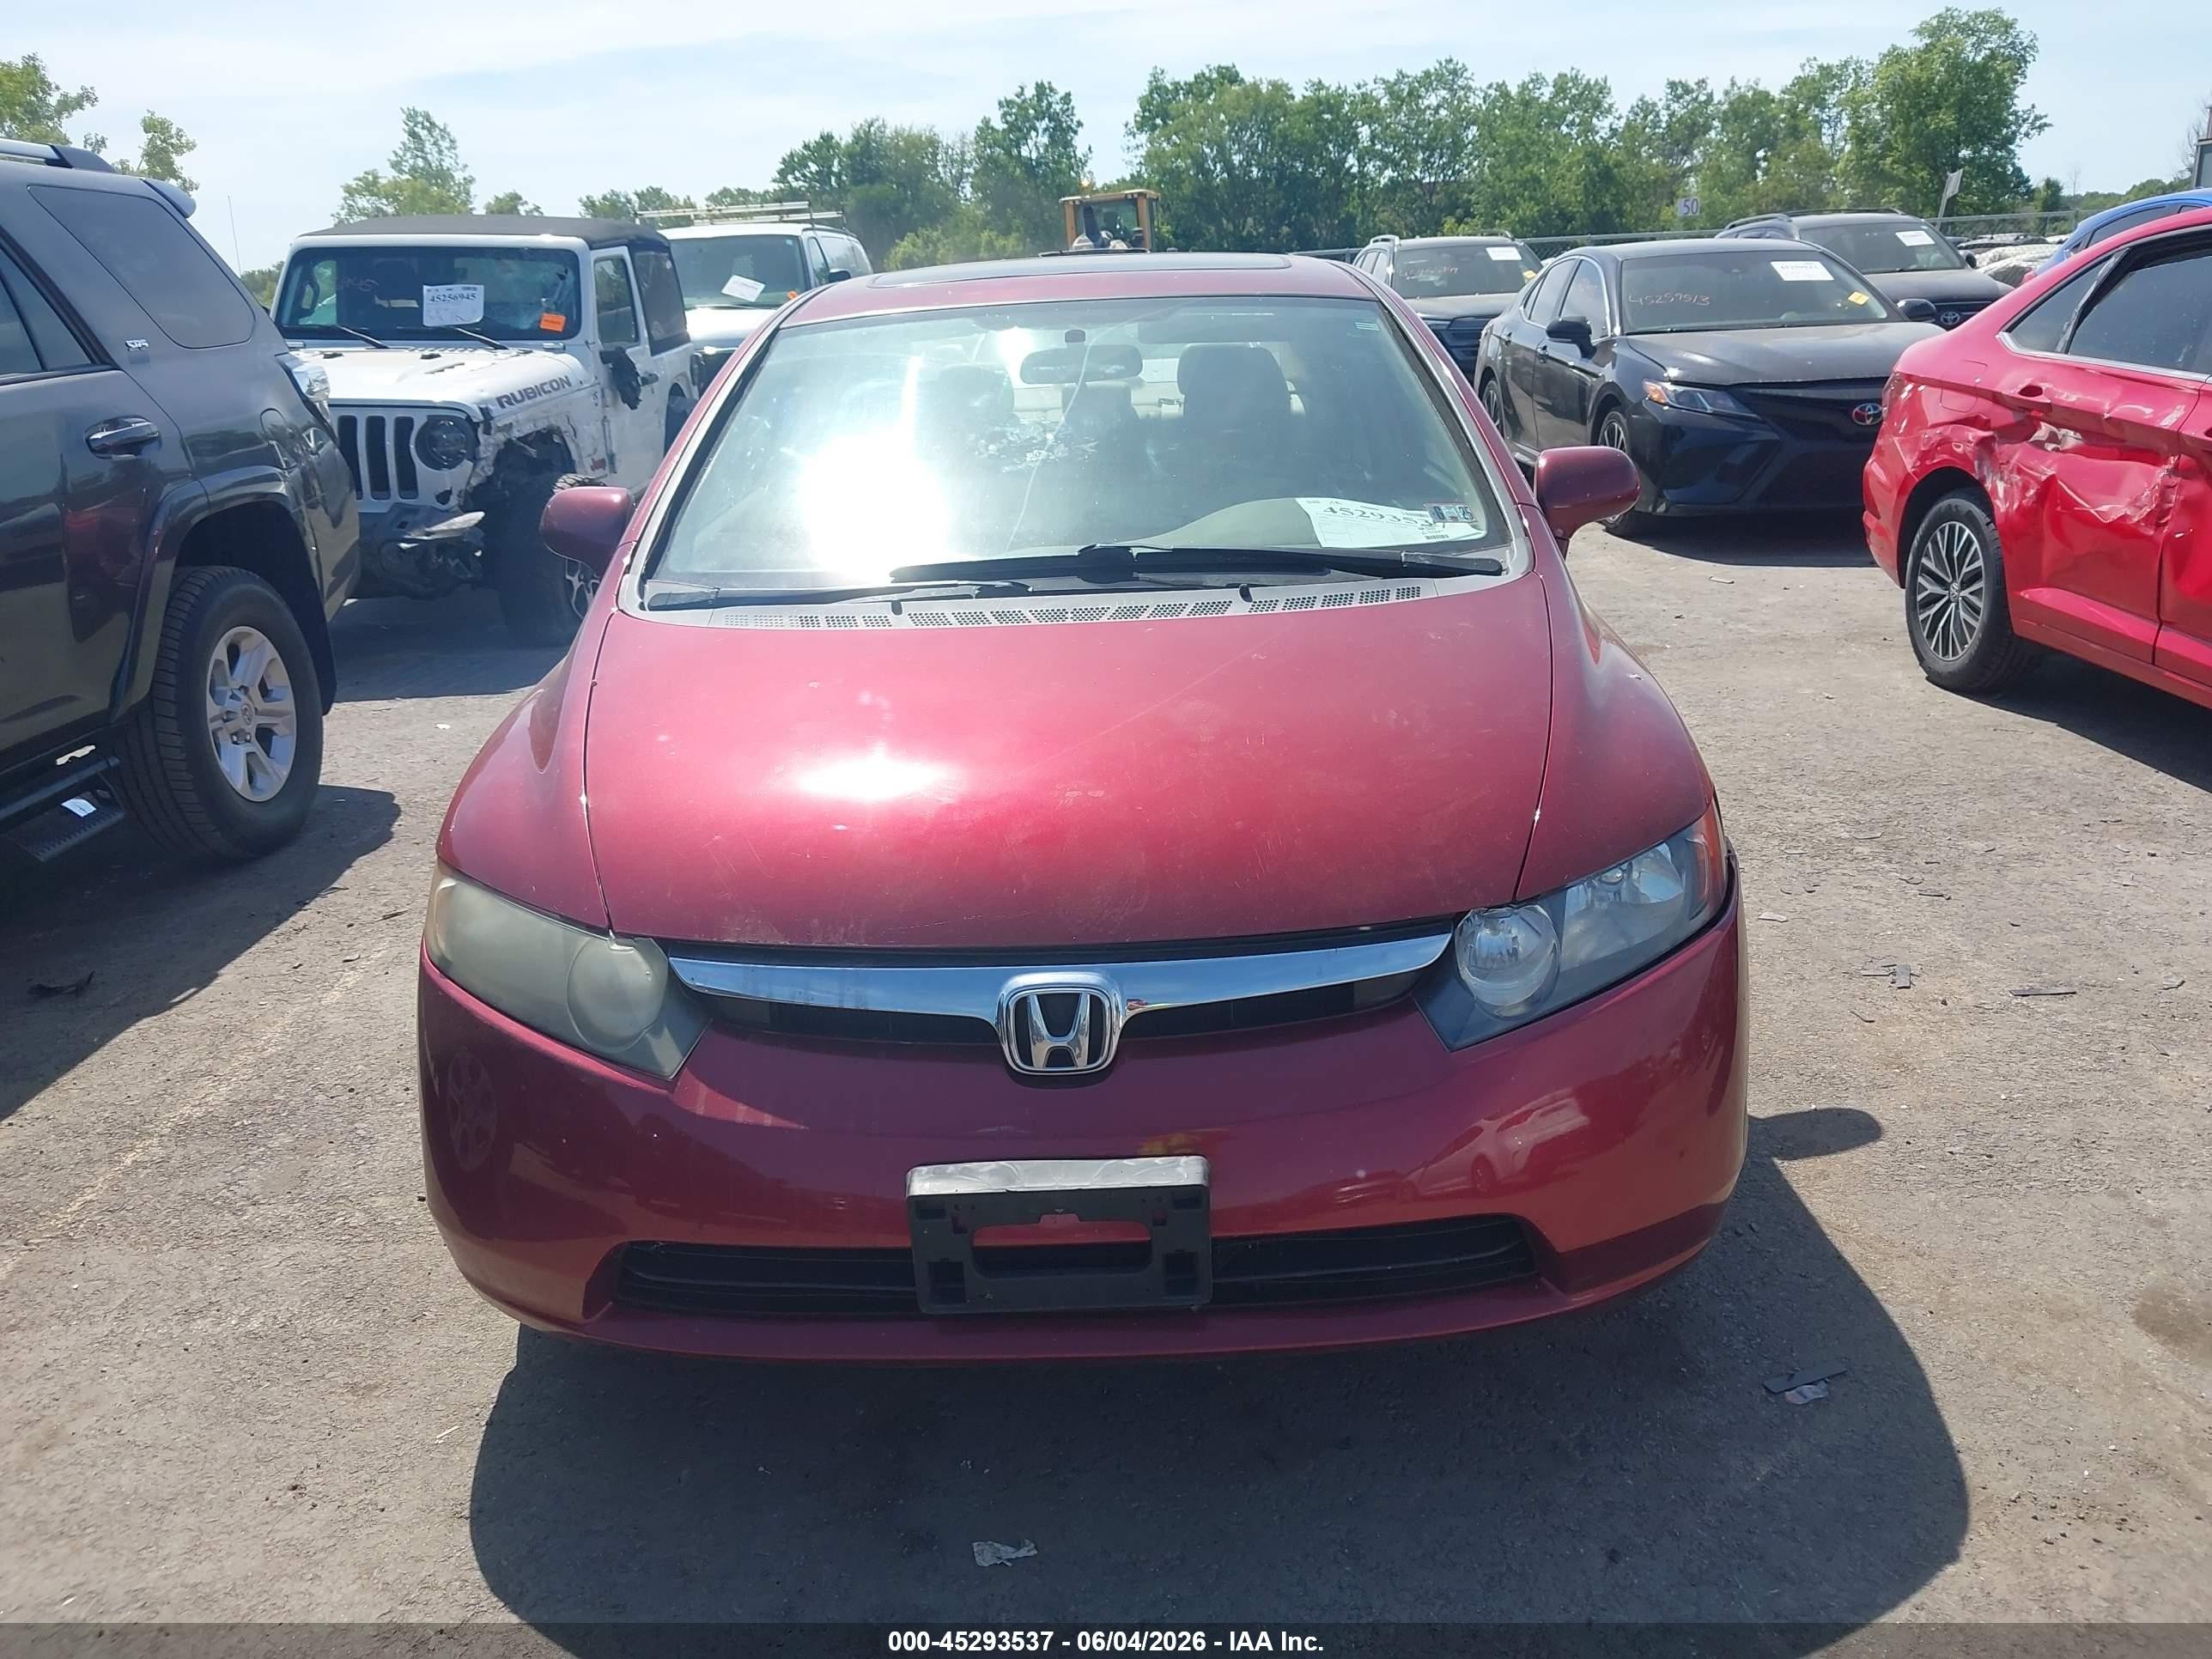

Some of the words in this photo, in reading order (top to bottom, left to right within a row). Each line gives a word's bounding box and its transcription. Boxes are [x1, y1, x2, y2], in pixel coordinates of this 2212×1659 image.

[1683, 198, 1698, 215] 50
[495, 374, 573, 410] RUBICON
[1323, 506, 1446, 530] 4529353
